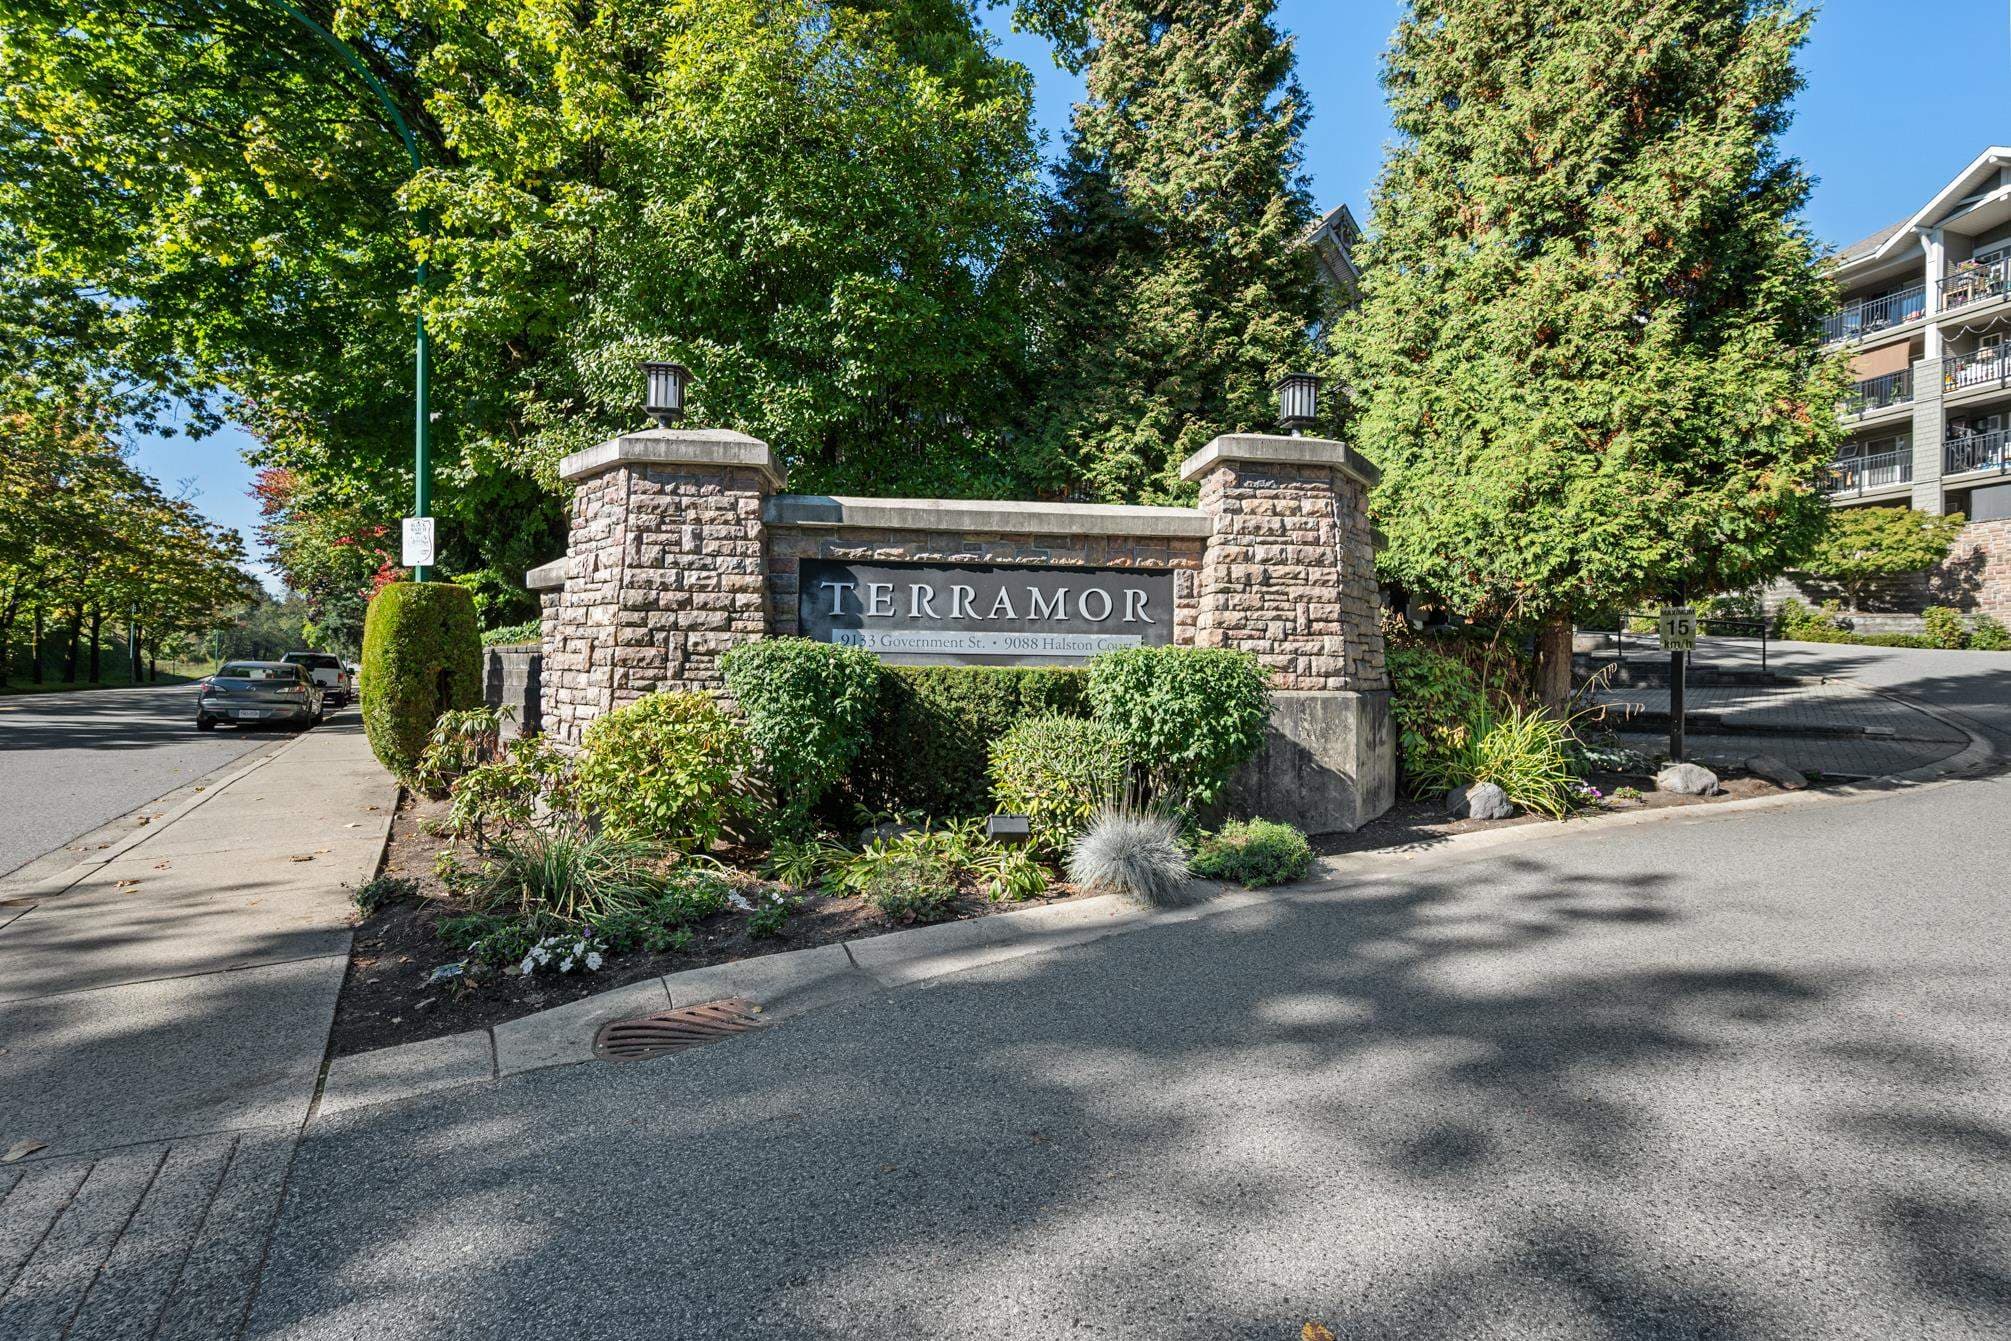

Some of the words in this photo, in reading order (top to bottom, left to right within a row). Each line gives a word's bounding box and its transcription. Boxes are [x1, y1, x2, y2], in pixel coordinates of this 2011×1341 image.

[820, 582, 1156, 623] TERRAMOR
[1661, 608, 1695, 616] MAXIMUM
[1666, 619, 1689, 636] 15
[841, 634, 876, 647] 9133
[880, 634, 963, 649] Government
[968, 636, 985, 649] St.
[1004, 636, 1038, 650] 9088
[1043, 637, 1092, 651] Halston
[1664, 640, 1692, 649] km/h
